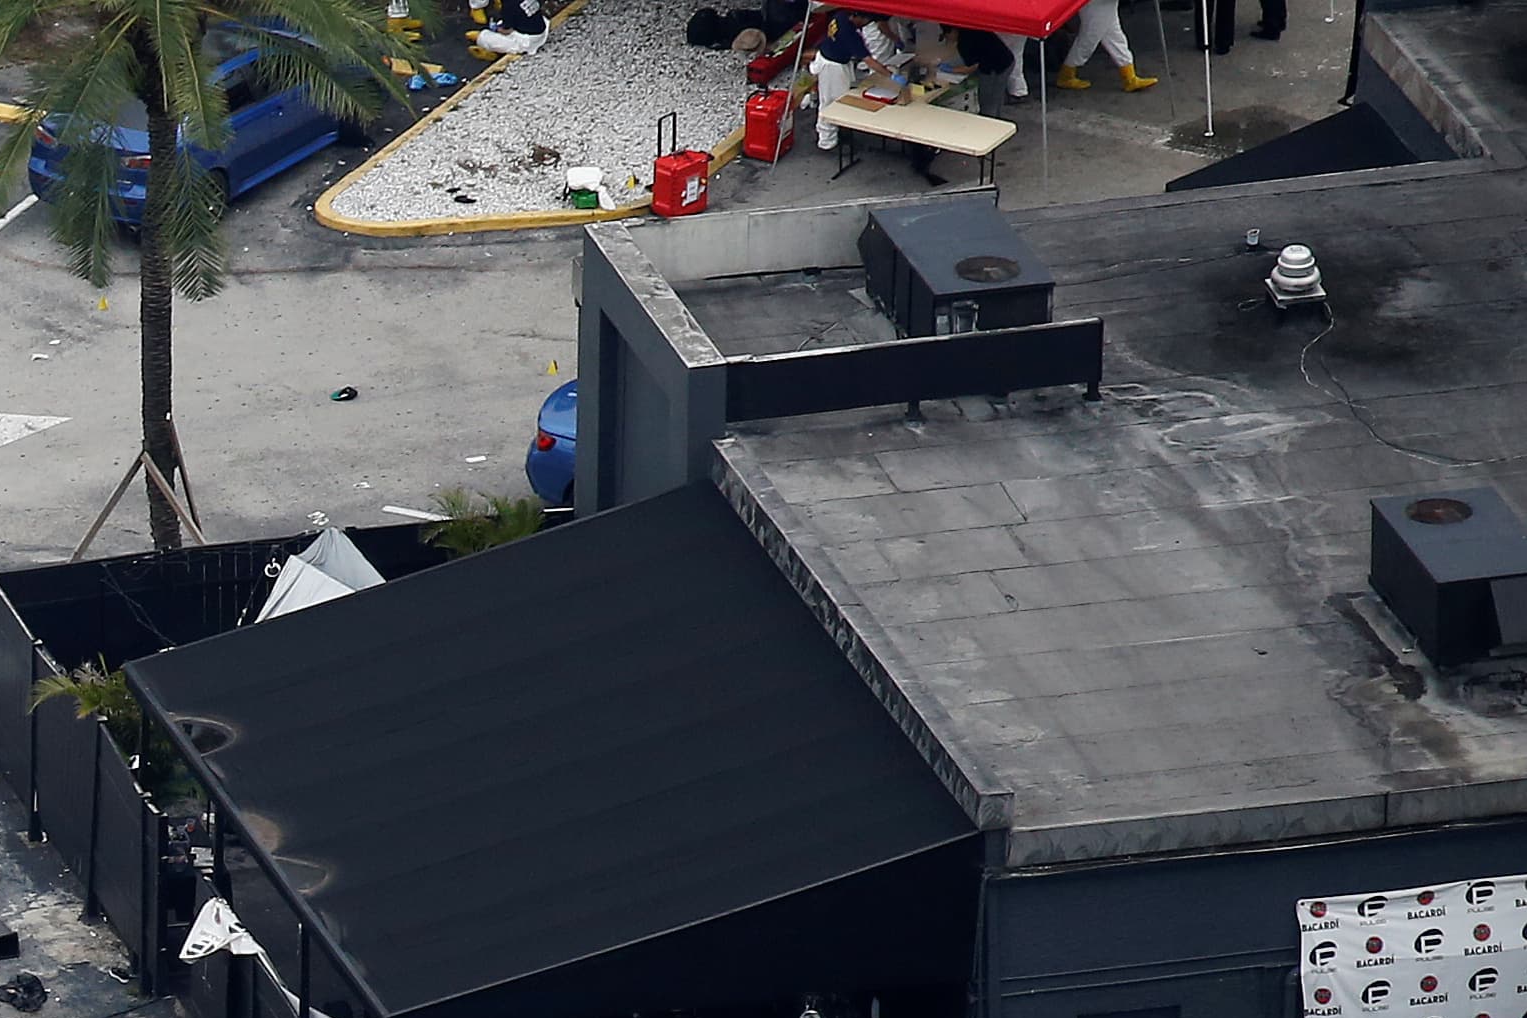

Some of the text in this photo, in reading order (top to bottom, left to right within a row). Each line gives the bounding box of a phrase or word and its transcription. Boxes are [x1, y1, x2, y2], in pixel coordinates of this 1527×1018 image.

[1407, 905, 1446, 920] BACARDÍ
[1302, 918, 1339, 932] BACARDÍ
[1464, 942, 1502, 956] BACARDÍ
[1356, 954, 1394, 968] BACARDÍ
[1410, 993, 1448, 1006] BACARDÍ
